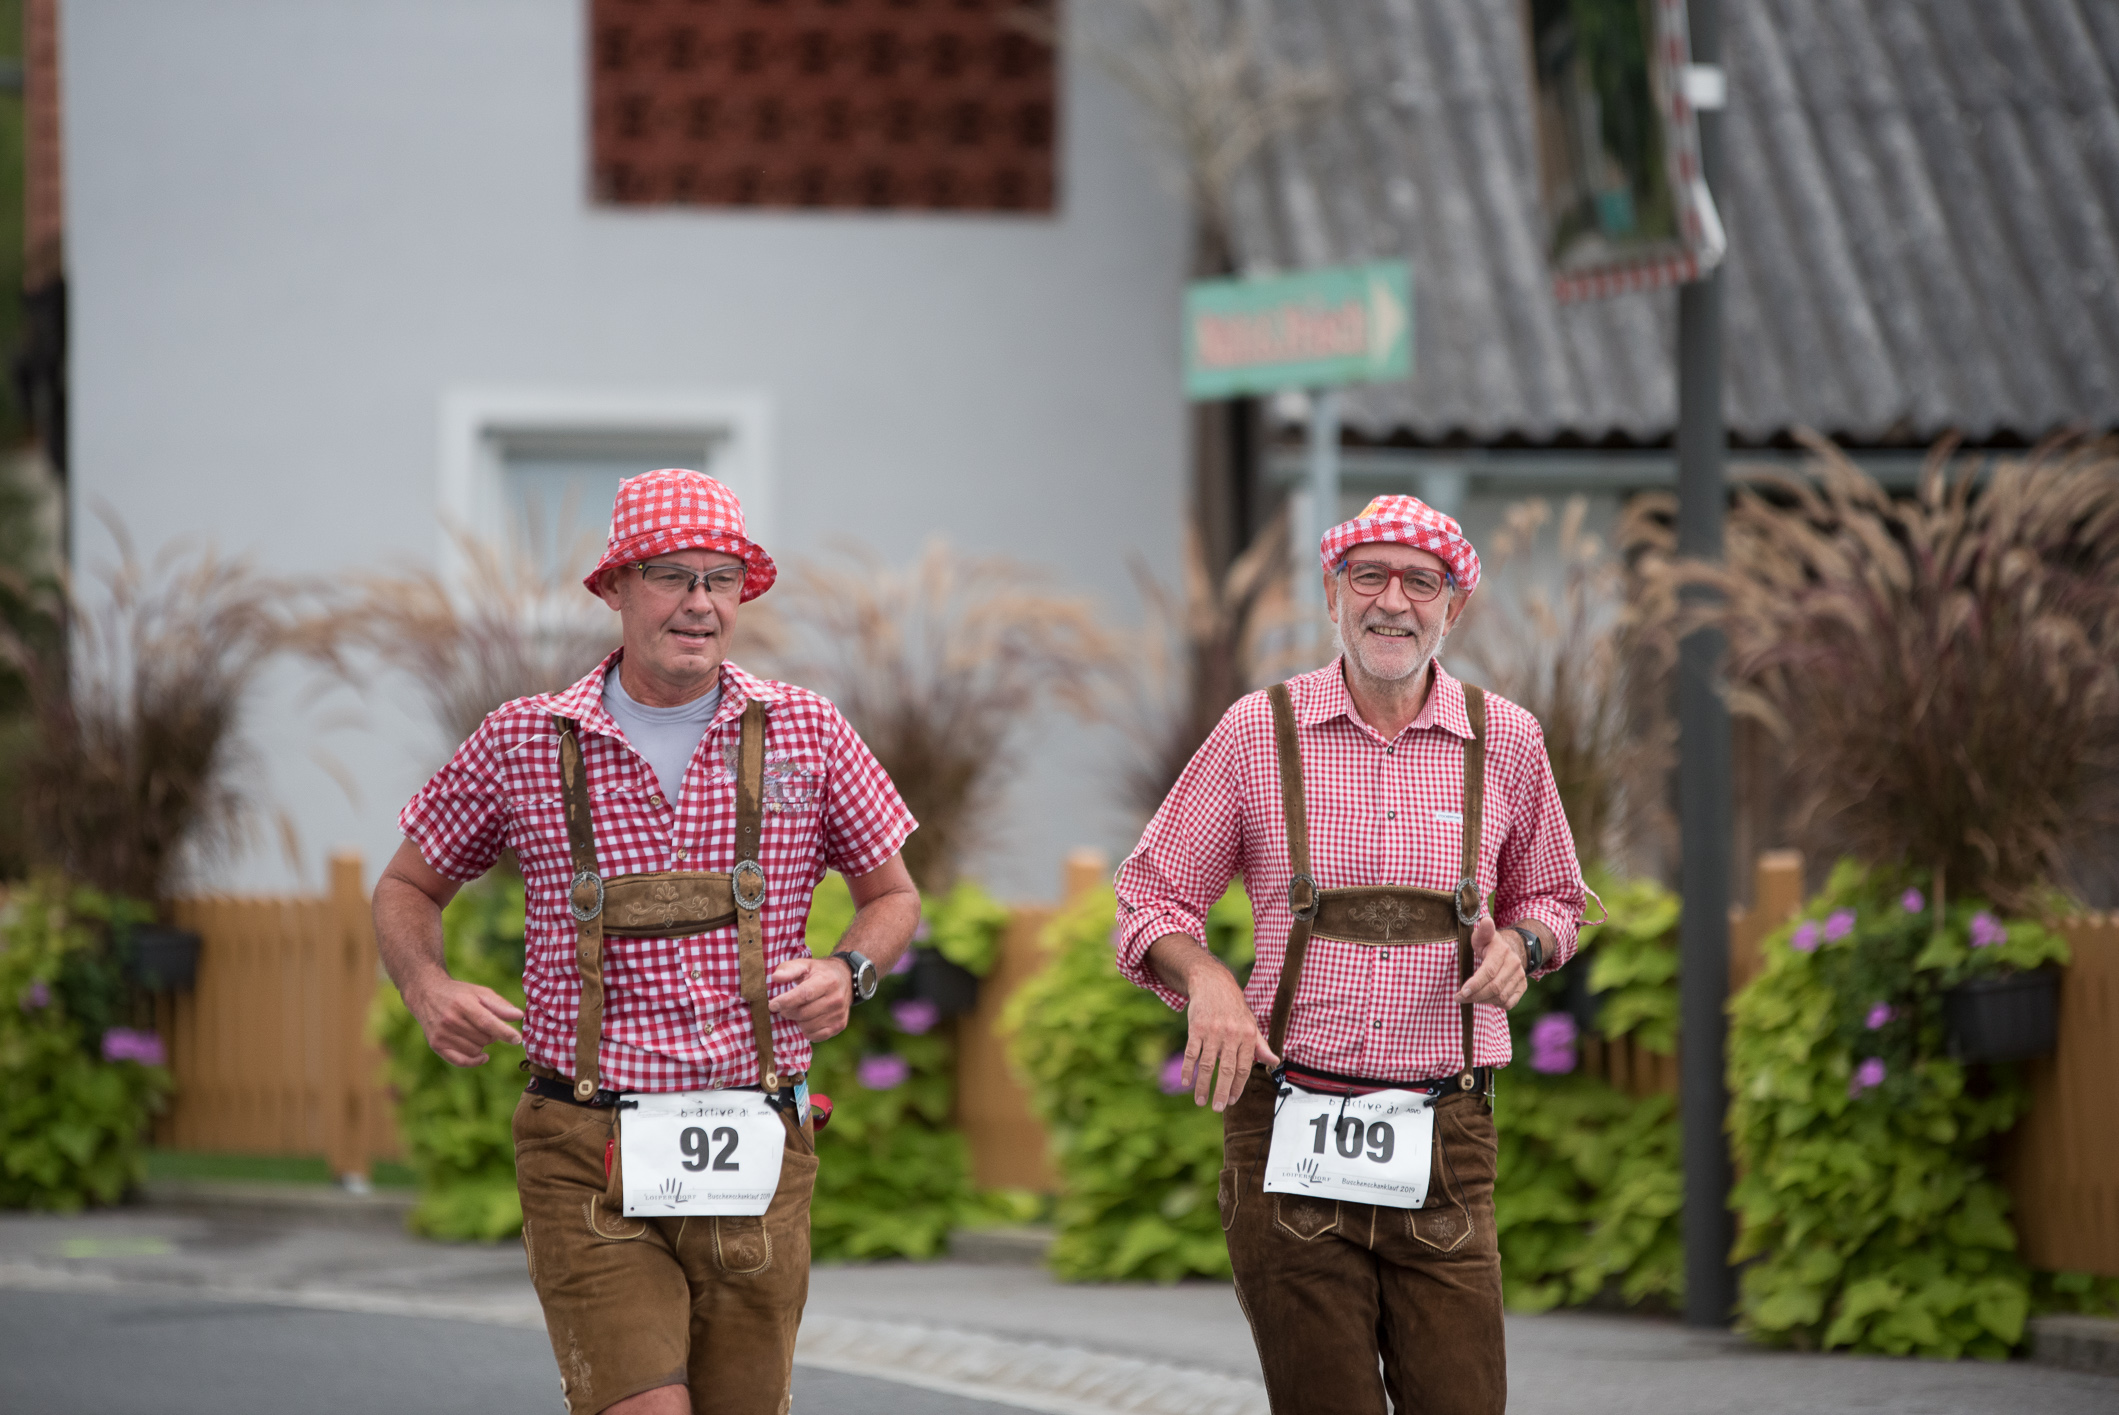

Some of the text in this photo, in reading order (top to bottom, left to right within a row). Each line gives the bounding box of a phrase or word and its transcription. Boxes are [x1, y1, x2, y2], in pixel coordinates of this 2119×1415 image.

[680, 1126, 740, 1172] 92
[1309, 1113, 1395, 1164] 109
[1282, 1171, 1331, 1182] LOIPERSDORF
[1341, 1177, 1415, 1194] Buschenschanklauf 2019
